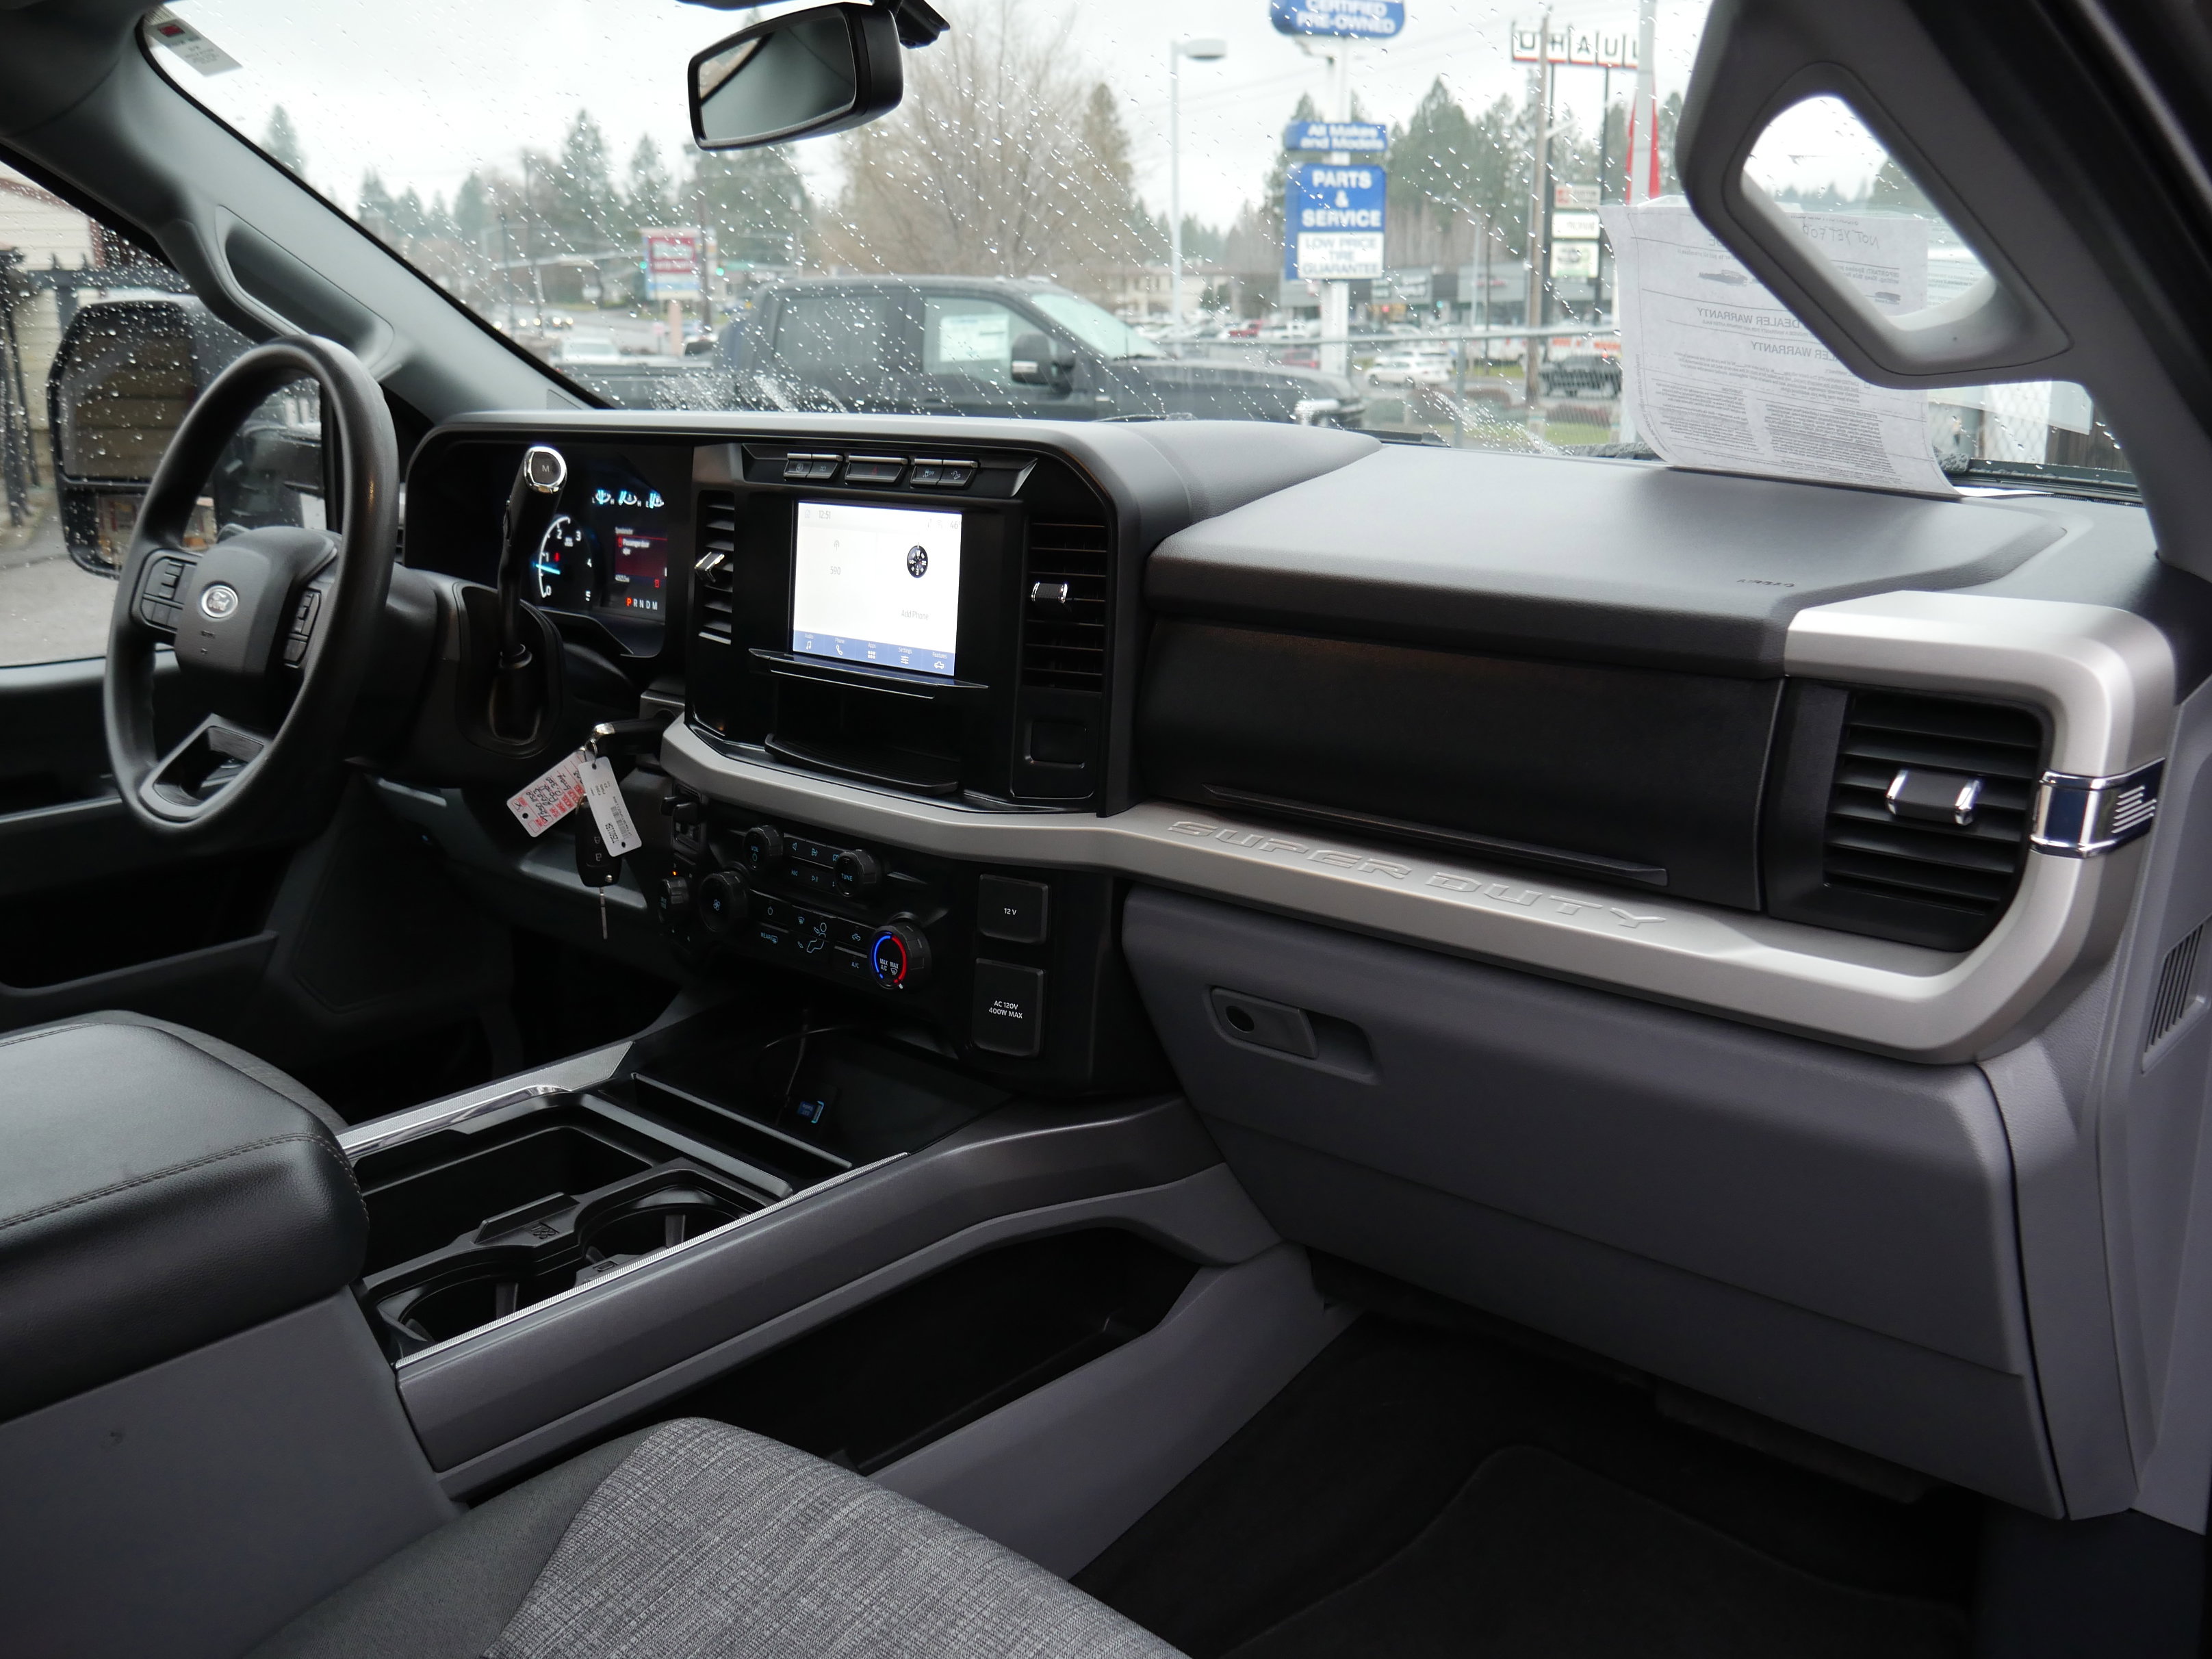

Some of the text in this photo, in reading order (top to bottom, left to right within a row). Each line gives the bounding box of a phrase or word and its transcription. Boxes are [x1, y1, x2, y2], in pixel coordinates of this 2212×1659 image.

[1296, 11, 1395, 34] PRE-OWNED
[1307, 124, 1378, 137] All Makes
[1300, 138, 1385, 150] and Models
[1312, 170, 1372, 189] PARTS
[1335, 190, 1350, 207] &
[1302, 209, 1382, 227] SERVICE
[1305, 238, 1377, 250] LOW PRICE
[1329, 250, 1354, 261] TIRE
[1302, 263, 1380, 275] GUARANTEE
[819, 510, 831, 520] 12:51
[576, 530, 582, 541] 3
[587, 558, 592, 567] 4
[830, 566, 841, 575] 590
[545, 586, 552, 595] 0
[626, 597, 632, 606] P
[639, 599, 644, 608] N
[646, 600, 650, 609] D
[652, 601, 658, 610] M
[901, 609, 929, 621] Add Phone
[898, 646, 912, 655] Settings
[932, 652, 948, 660] Features
[1168, 821, 1667, 929] SUPER DUTY
[761, 932, 771, 941] REAR
[890, 962, 899, 970] MAX
[988, 1007, 1023, 1019] 400W MAX
